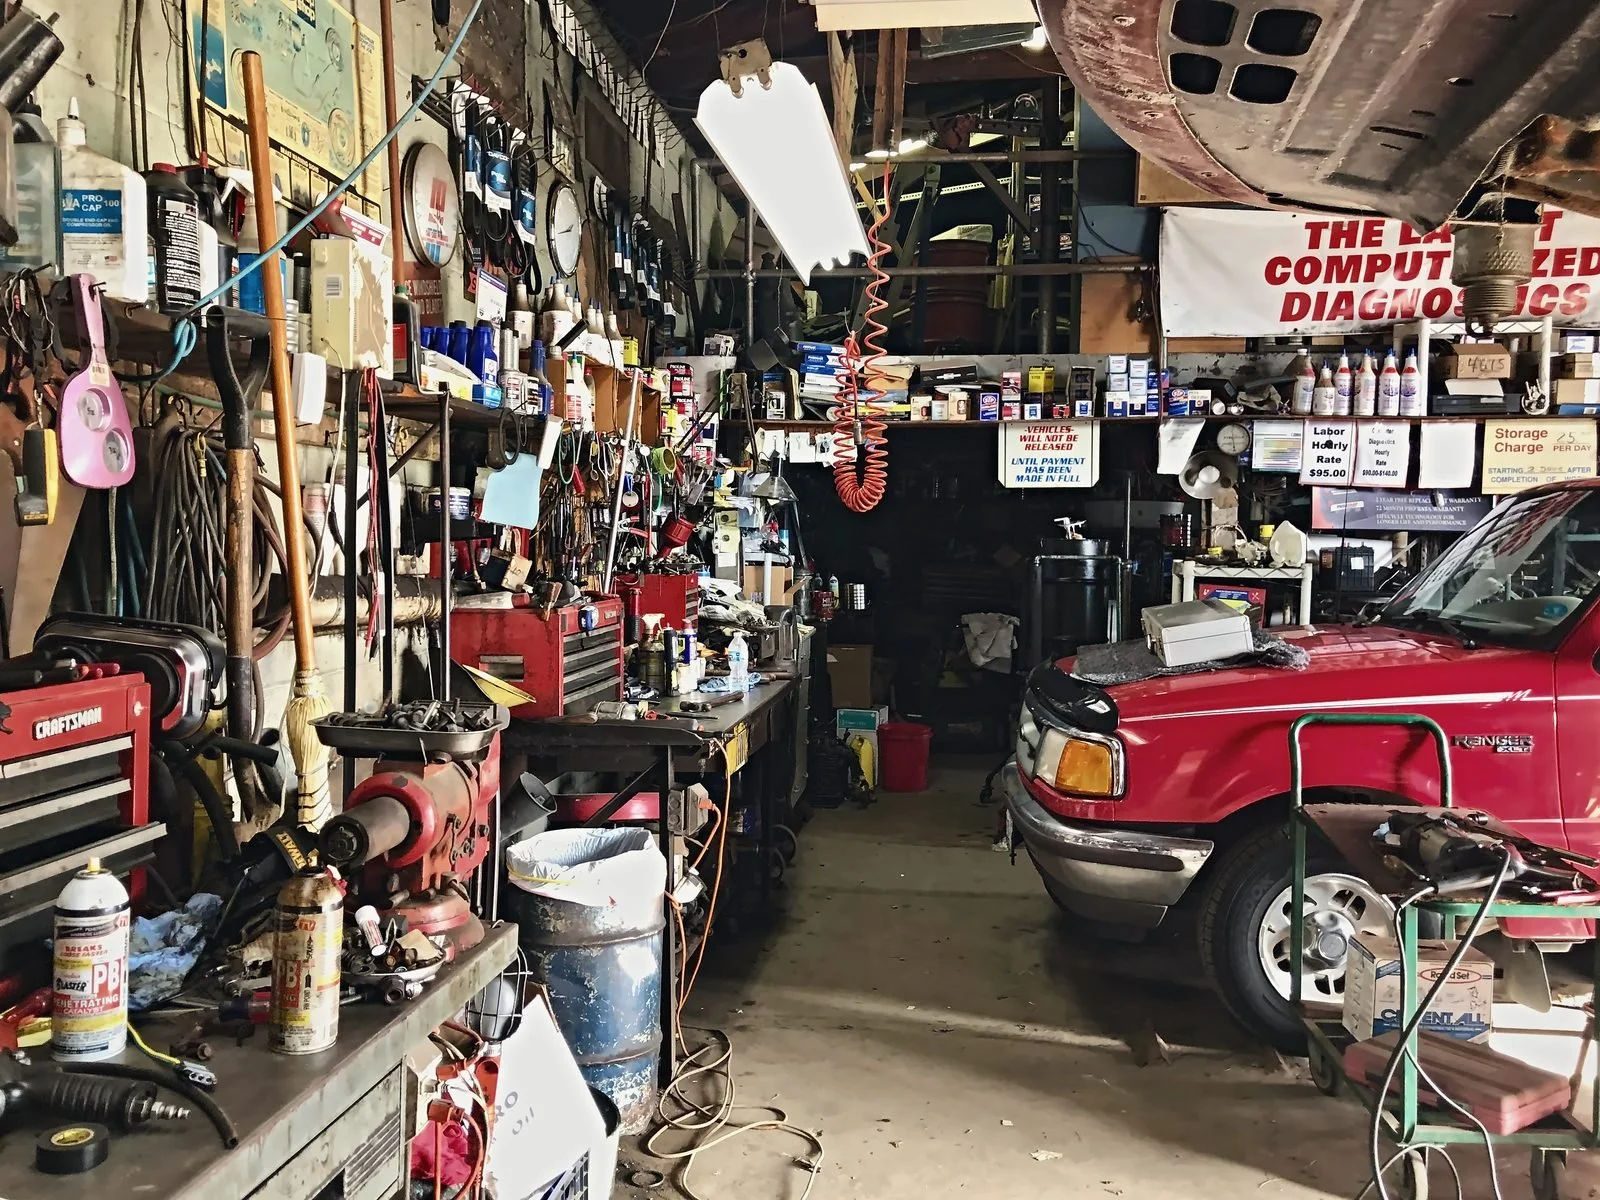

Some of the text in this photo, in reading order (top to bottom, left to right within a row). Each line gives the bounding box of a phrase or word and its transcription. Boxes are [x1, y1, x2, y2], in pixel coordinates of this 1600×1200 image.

[81, 204, 102, 212] CAP
[1304, 220, 1385, 250] THE
[1264, 247, 1600, 286] COMPUTZED
[1313, 427, 1345, 436] Labor
[1495, 428, 1548, 441] Storage
[1025, 443, 1074, 451] RELEASED
[1494, 442, 1544, 455] Charge
[1374, 449, 1390, 457] Hourly
[1316, 456, 1342, 464] Rate
[1025, 466, 1072, 474] HAS BEEN
[1309, 469, 1346, 478] $95.00
[35, 707, 102, 740] CRAFTSMAN
[65, 945, 103, 953] BREAKS
[93, 960, 120, 994] PB
[1457, 972, 1470, 980] Set
